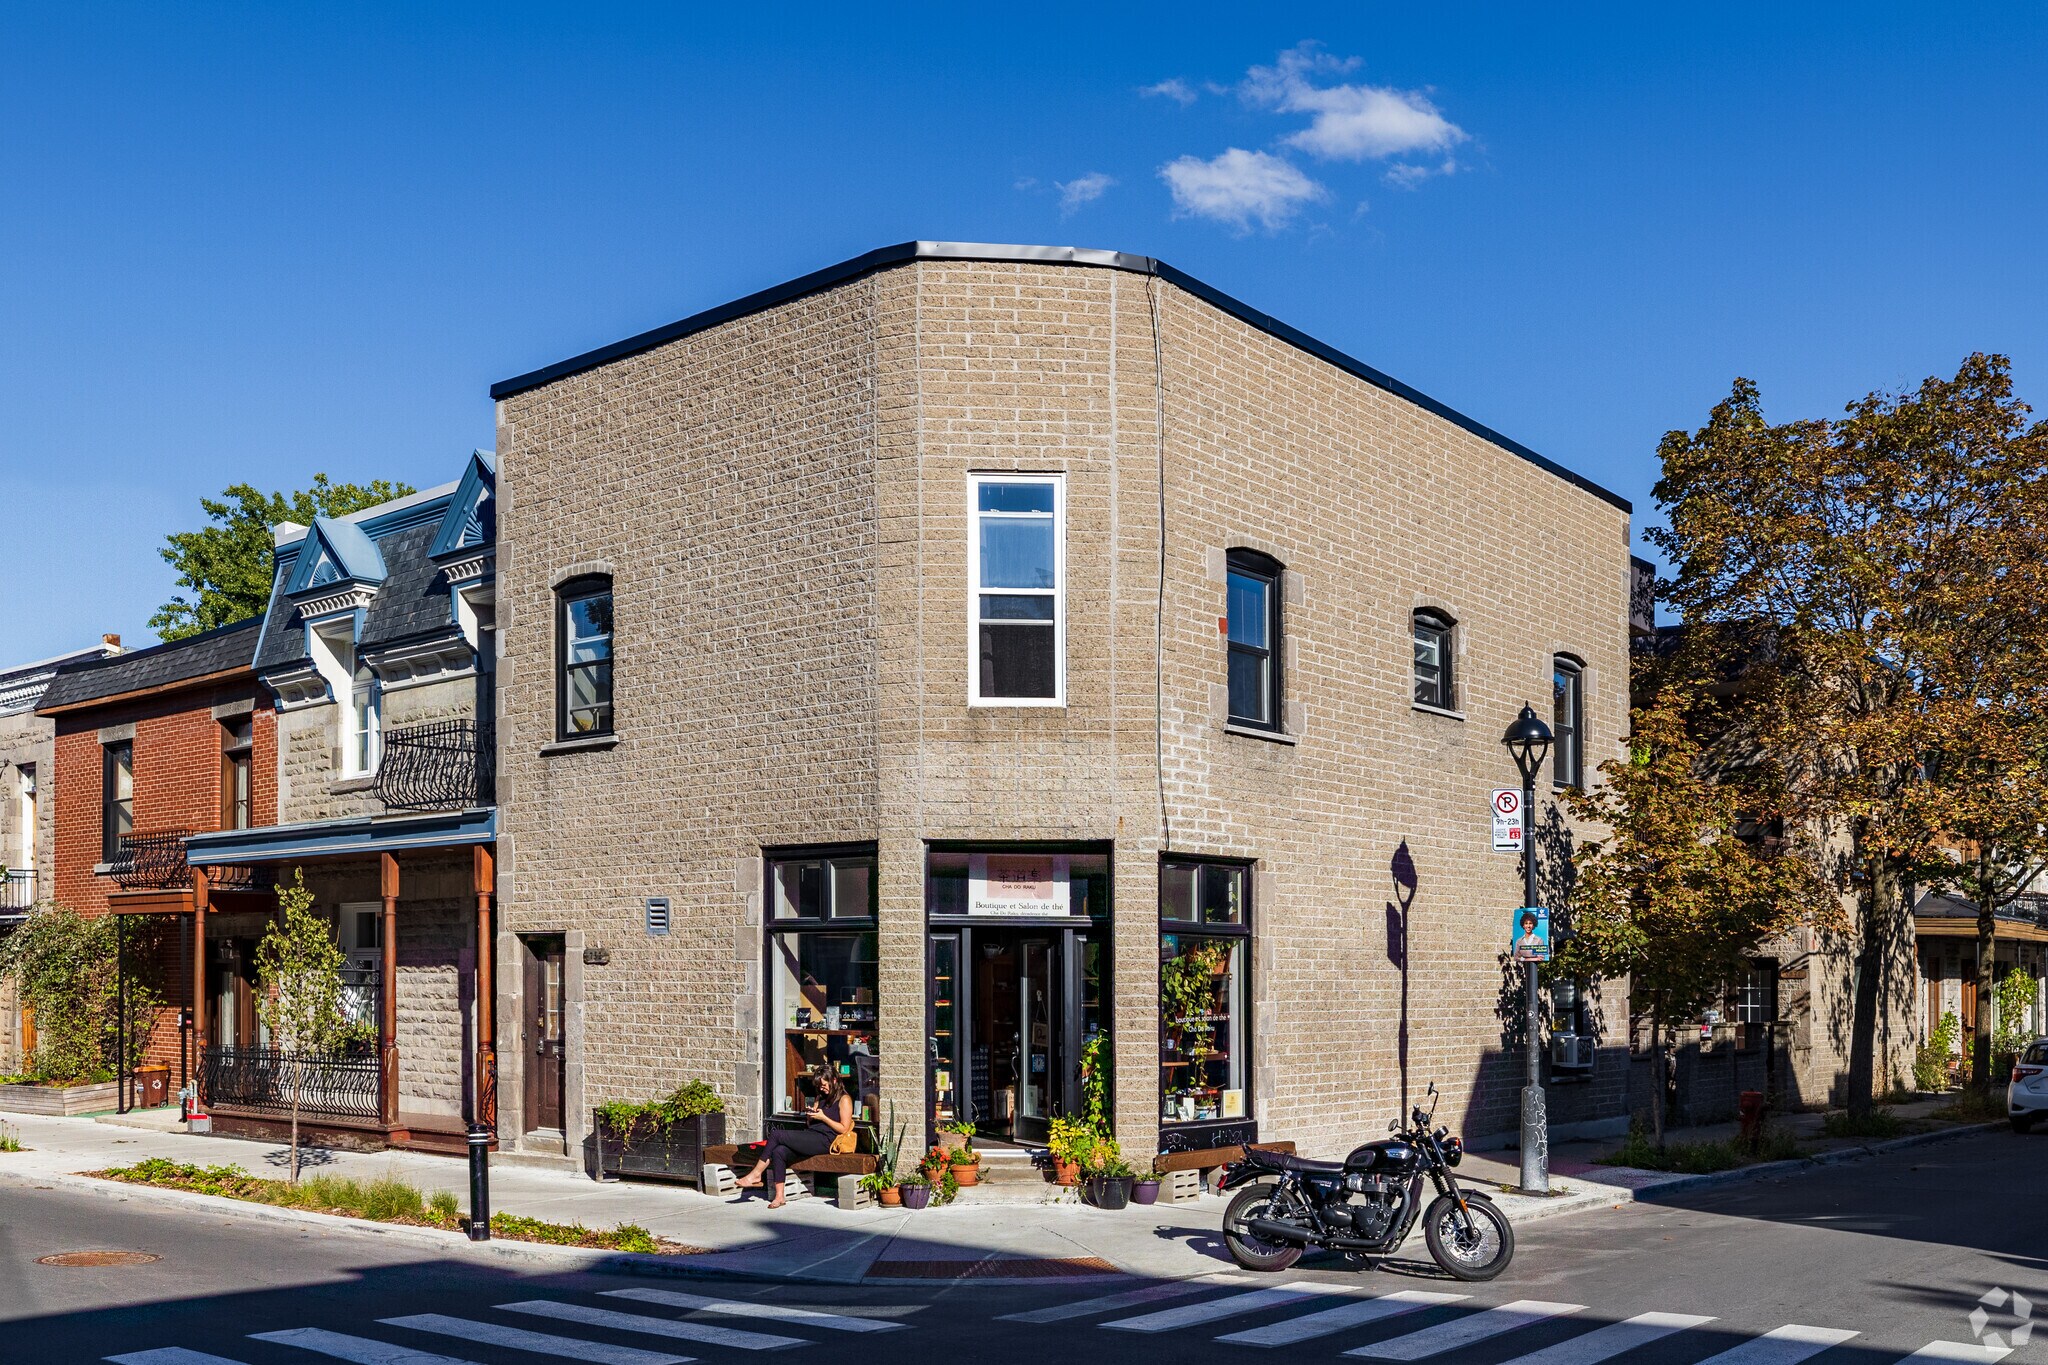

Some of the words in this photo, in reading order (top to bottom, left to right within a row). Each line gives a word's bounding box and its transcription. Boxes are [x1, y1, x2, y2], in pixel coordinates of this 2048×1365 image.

[1495, 817, 1520, 825] 9h-23h
[975, 901, 1008, 911] Boutique
[1018, 902, 1038, 910] Salon
